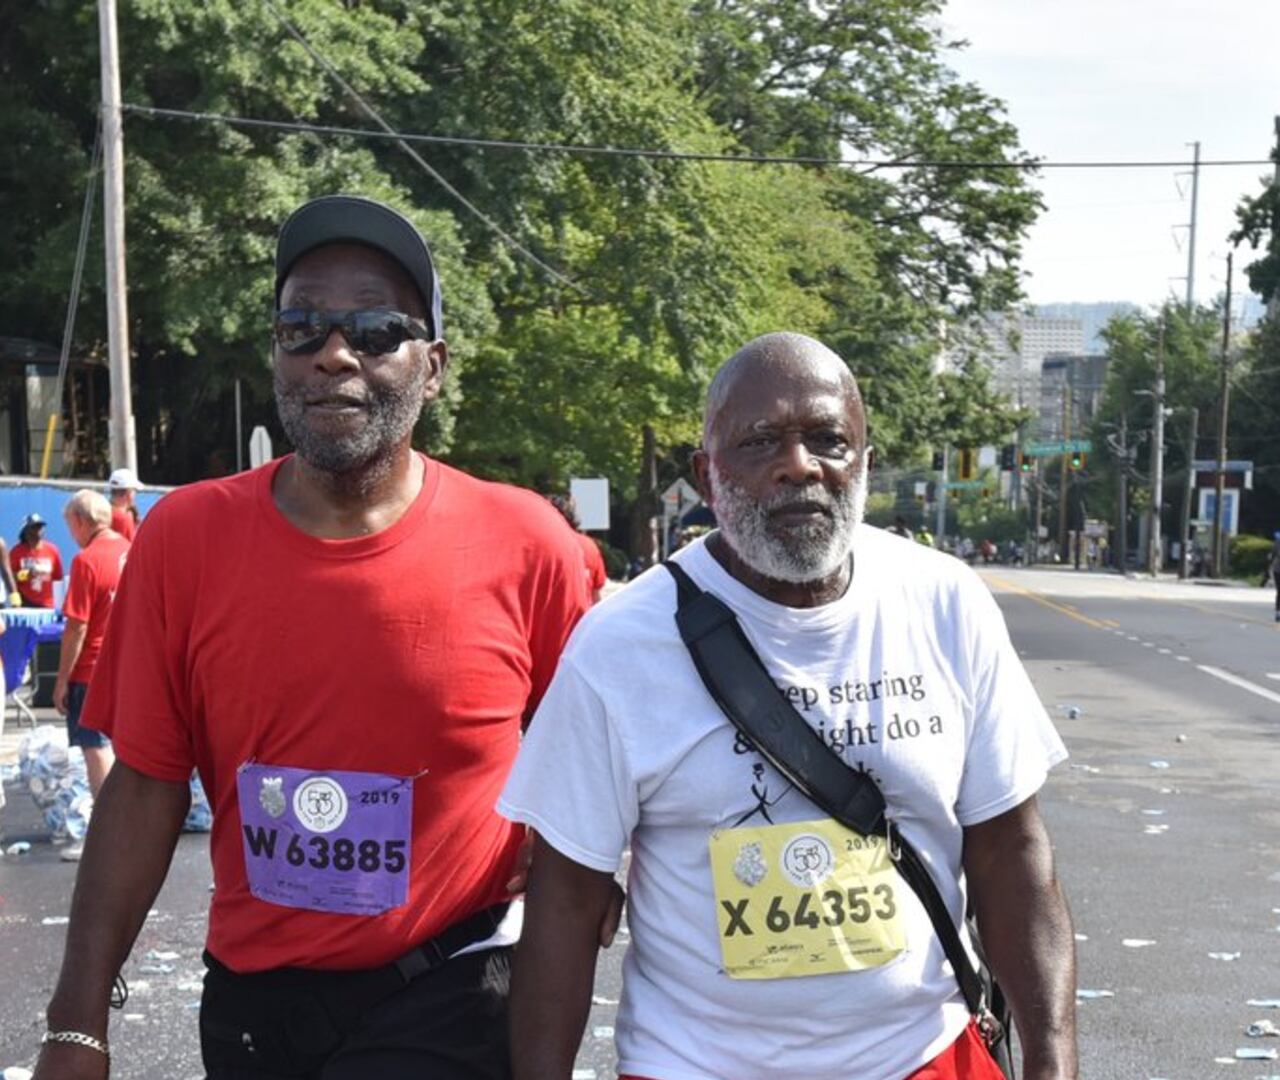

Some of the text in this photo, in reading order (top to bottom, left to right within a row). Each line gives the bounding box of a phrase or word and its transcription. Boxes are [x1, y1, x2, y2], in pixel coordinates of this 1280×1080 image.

[779, 671, 926, 711] ep staring
[819, 719, 879, 754] ight
[887, 713, 921, 740] do
[929, 715, 944, 735] a
[360, 791, 400, 805] 2019
[243, 825, 406, 874] W 63885
[846, 836, 878, 851] 2019
[721, 884, 896, 936] X 64353
